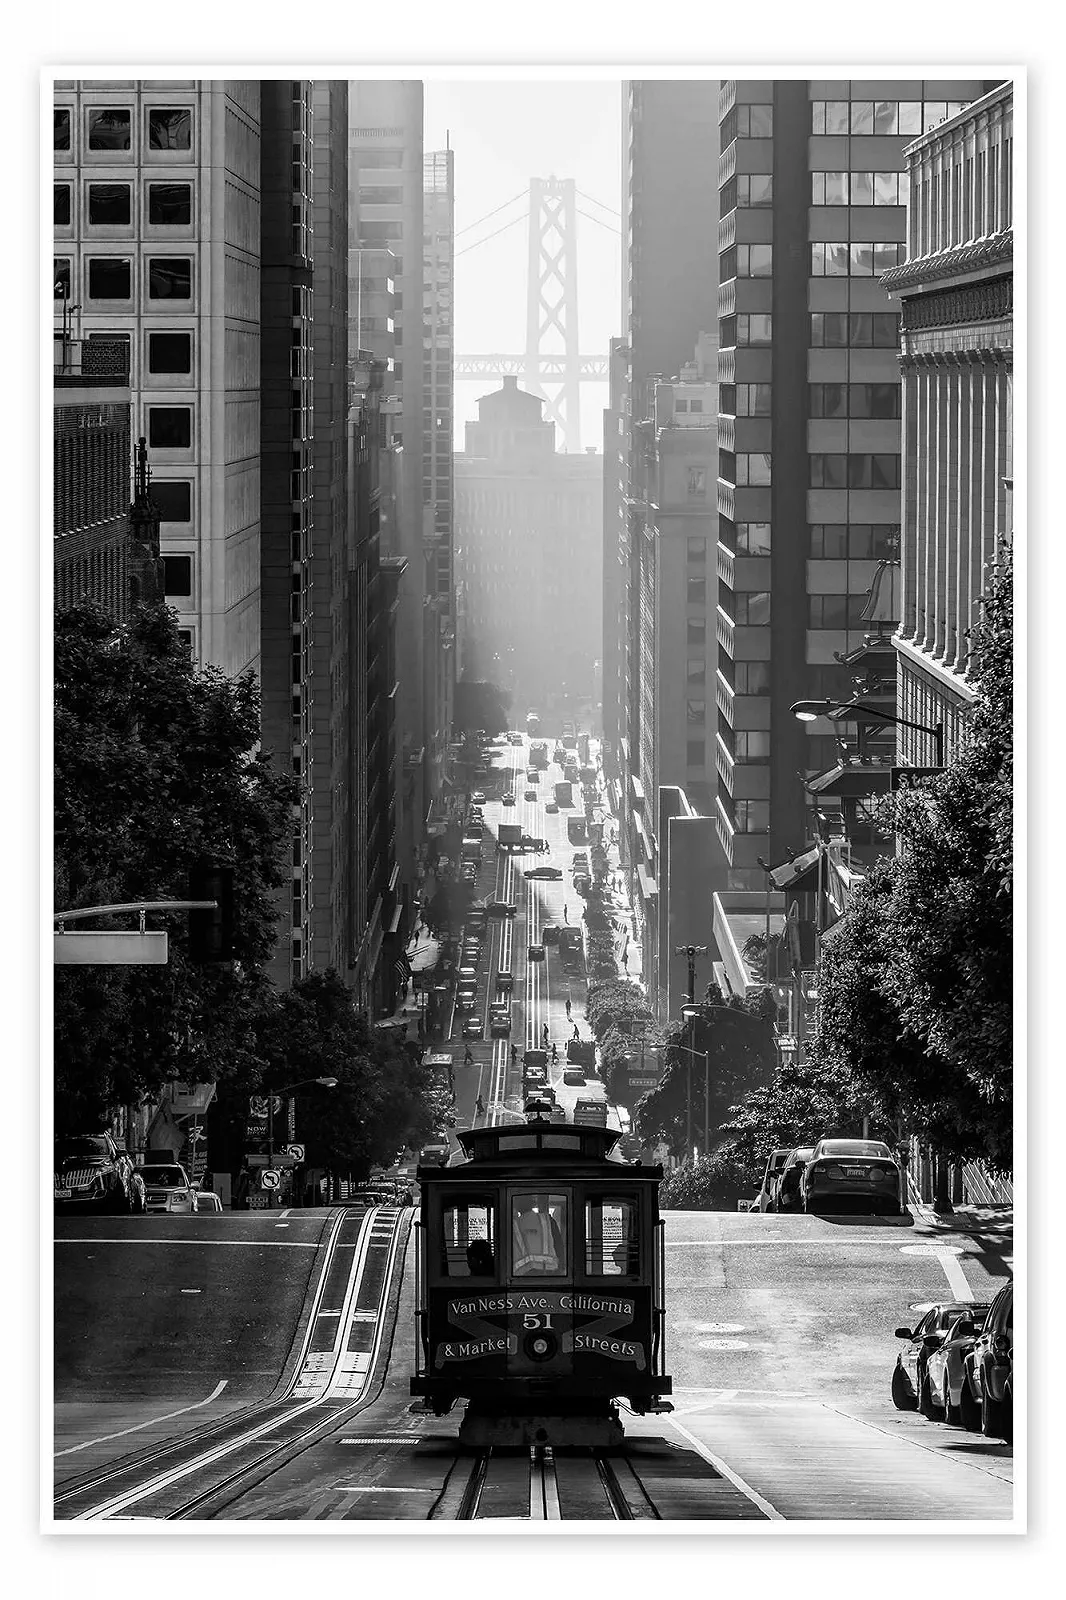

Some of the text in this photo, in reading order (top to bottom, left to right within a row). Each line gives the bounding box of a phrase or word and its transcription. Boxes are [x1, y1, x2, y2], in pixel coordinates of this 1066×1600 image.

[452, 1302, 477, 1314] Van
[479, 1298, 513, 1311] Ness
[560, 1296, 632, 1314] California
[523, 1313, 555, 1330] 51
[445, 1335, 636, 1357] & Market Streets
